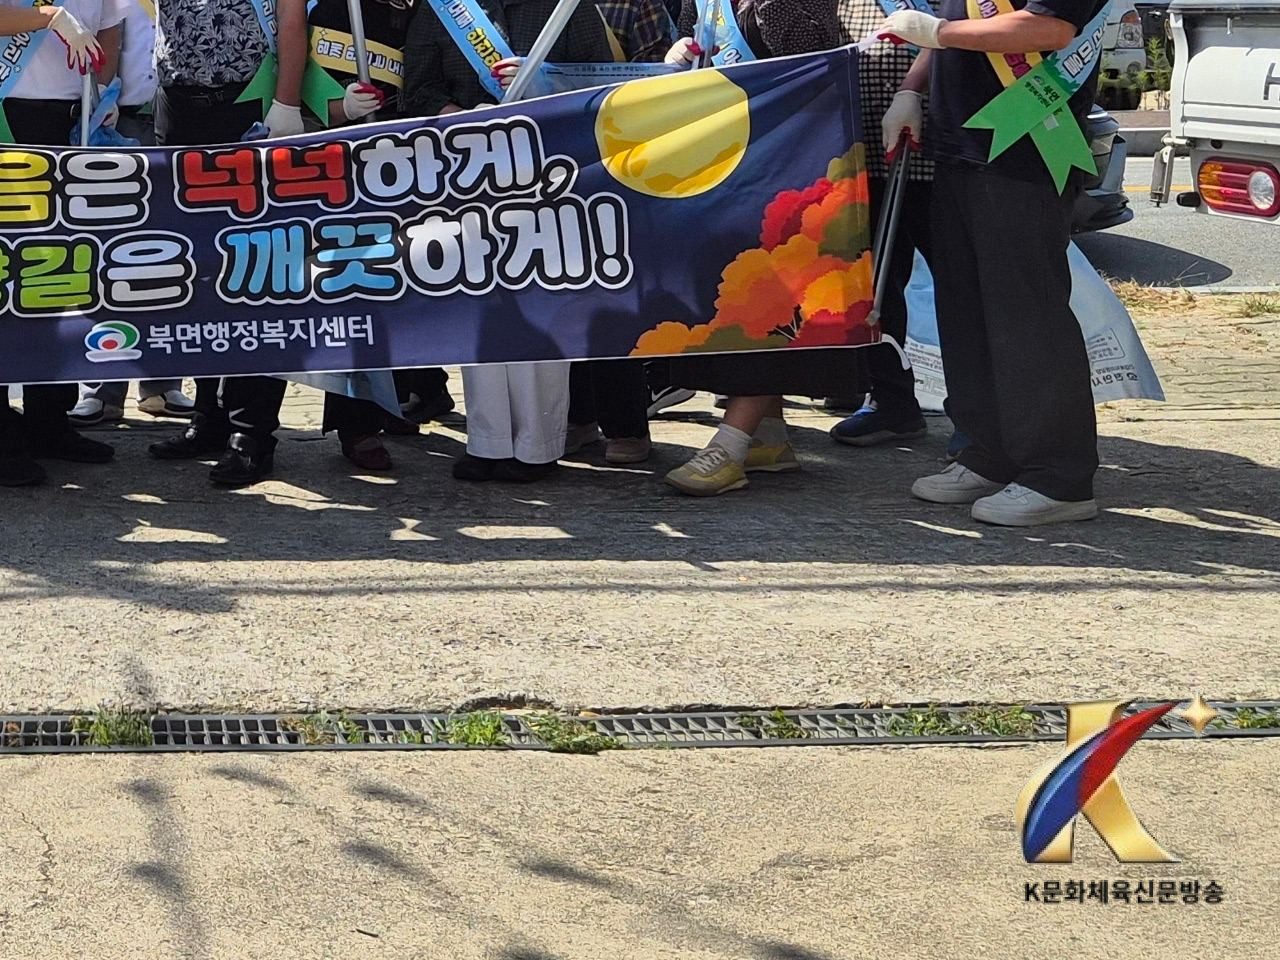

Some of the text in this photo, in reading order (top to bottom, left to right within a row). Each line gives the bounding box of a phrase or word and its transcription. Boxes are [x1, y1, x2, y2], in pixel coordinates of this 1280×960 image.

[1061, 43, 1094, 78] 마을
[177, 119, 576, 218] 넉넉하게,
[219, 196, 630, 302] 깨끗하게!
[146, 314, 375, 355] 북면행정복지센터
